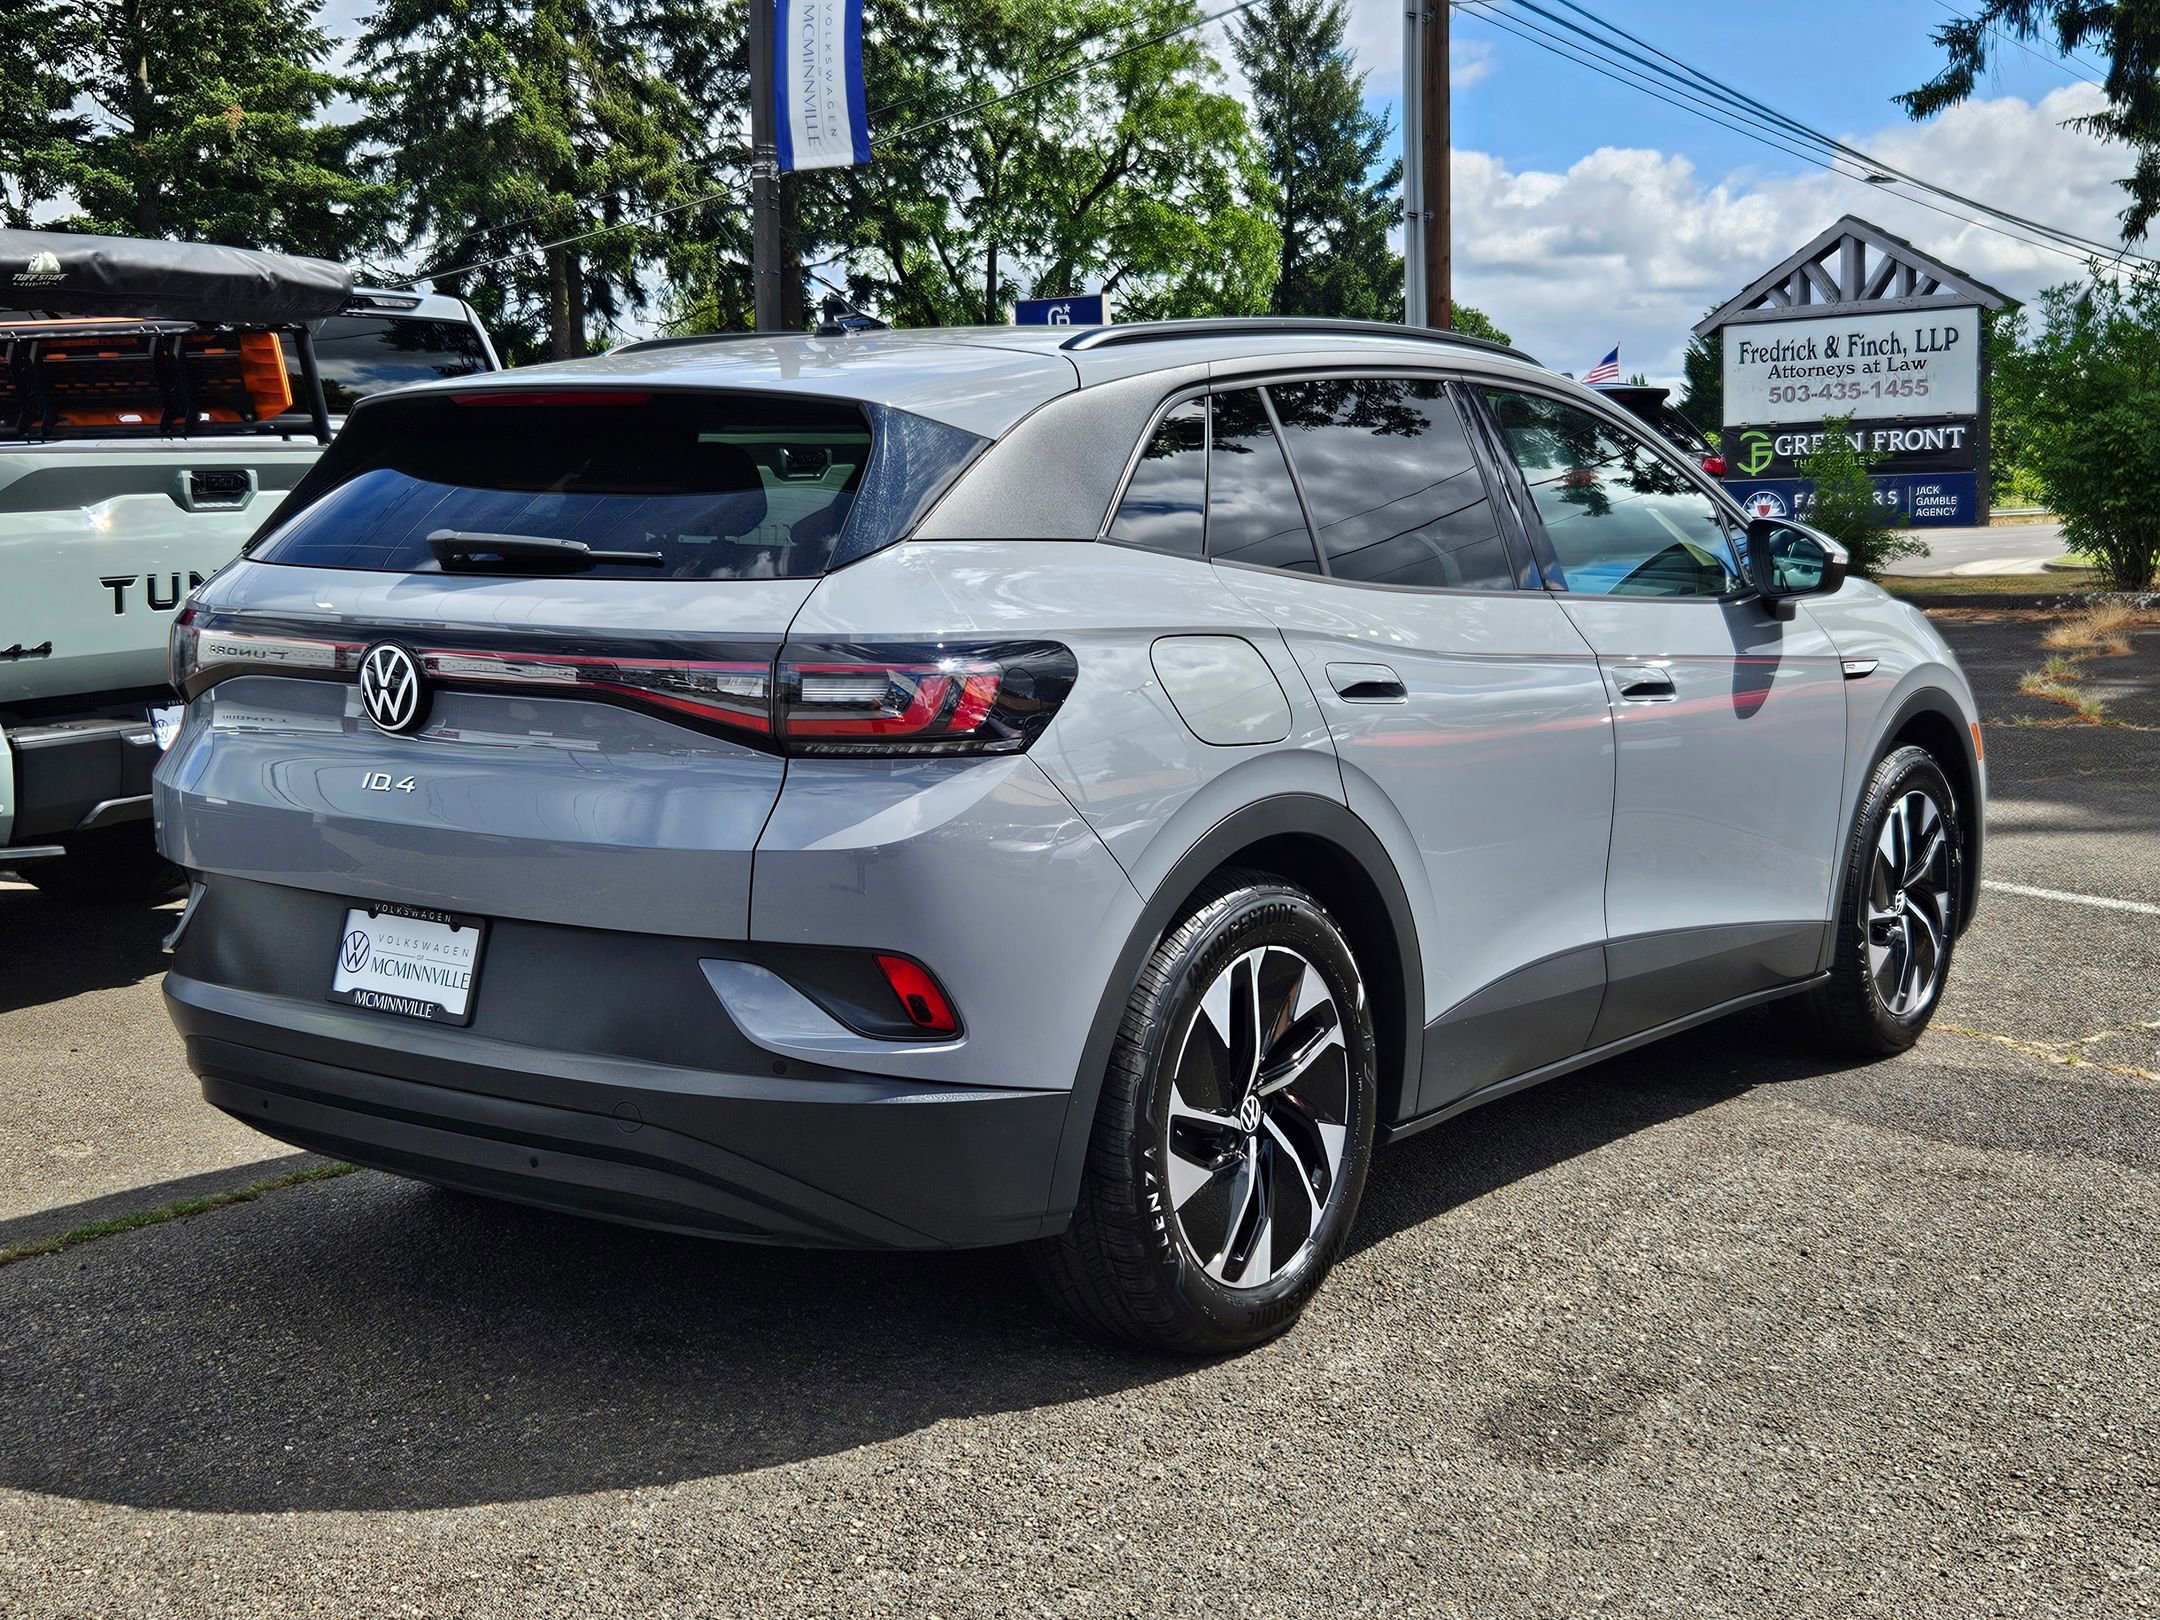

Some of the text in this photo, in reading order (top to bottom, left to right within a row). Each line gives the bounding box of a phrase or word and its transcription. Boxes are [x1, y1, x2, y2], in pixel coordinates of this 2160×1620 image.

[802, 4, 822, 147] MCMINNVILLE
[824, 3, 838, 137] VOLKSWAGEN
[1738, 327, 1959, 365] Fredrick & Finch, LLP
[1767, 357, 1928, 380] Attorneys at Law
[1768, 379, 1929, 404] 503-435-1455
[1872, 427, 1965, 453] FRONT
[1794, 490, 1898, 508] FARS
[1916, 485, 1940, 495] JACK
[1916, 496, 1957, 506] GAMBLE
[1916, 506, 1957, 517] AGENCY
[374, 903, 452, 922] VOLKSWAGEN
[378, 934, 470, 957] VOLKSWAGEN
[370, 957, 471, 990] MCMINNVILLE
[354, 990, 434, 1018] MCMINNVILLE
